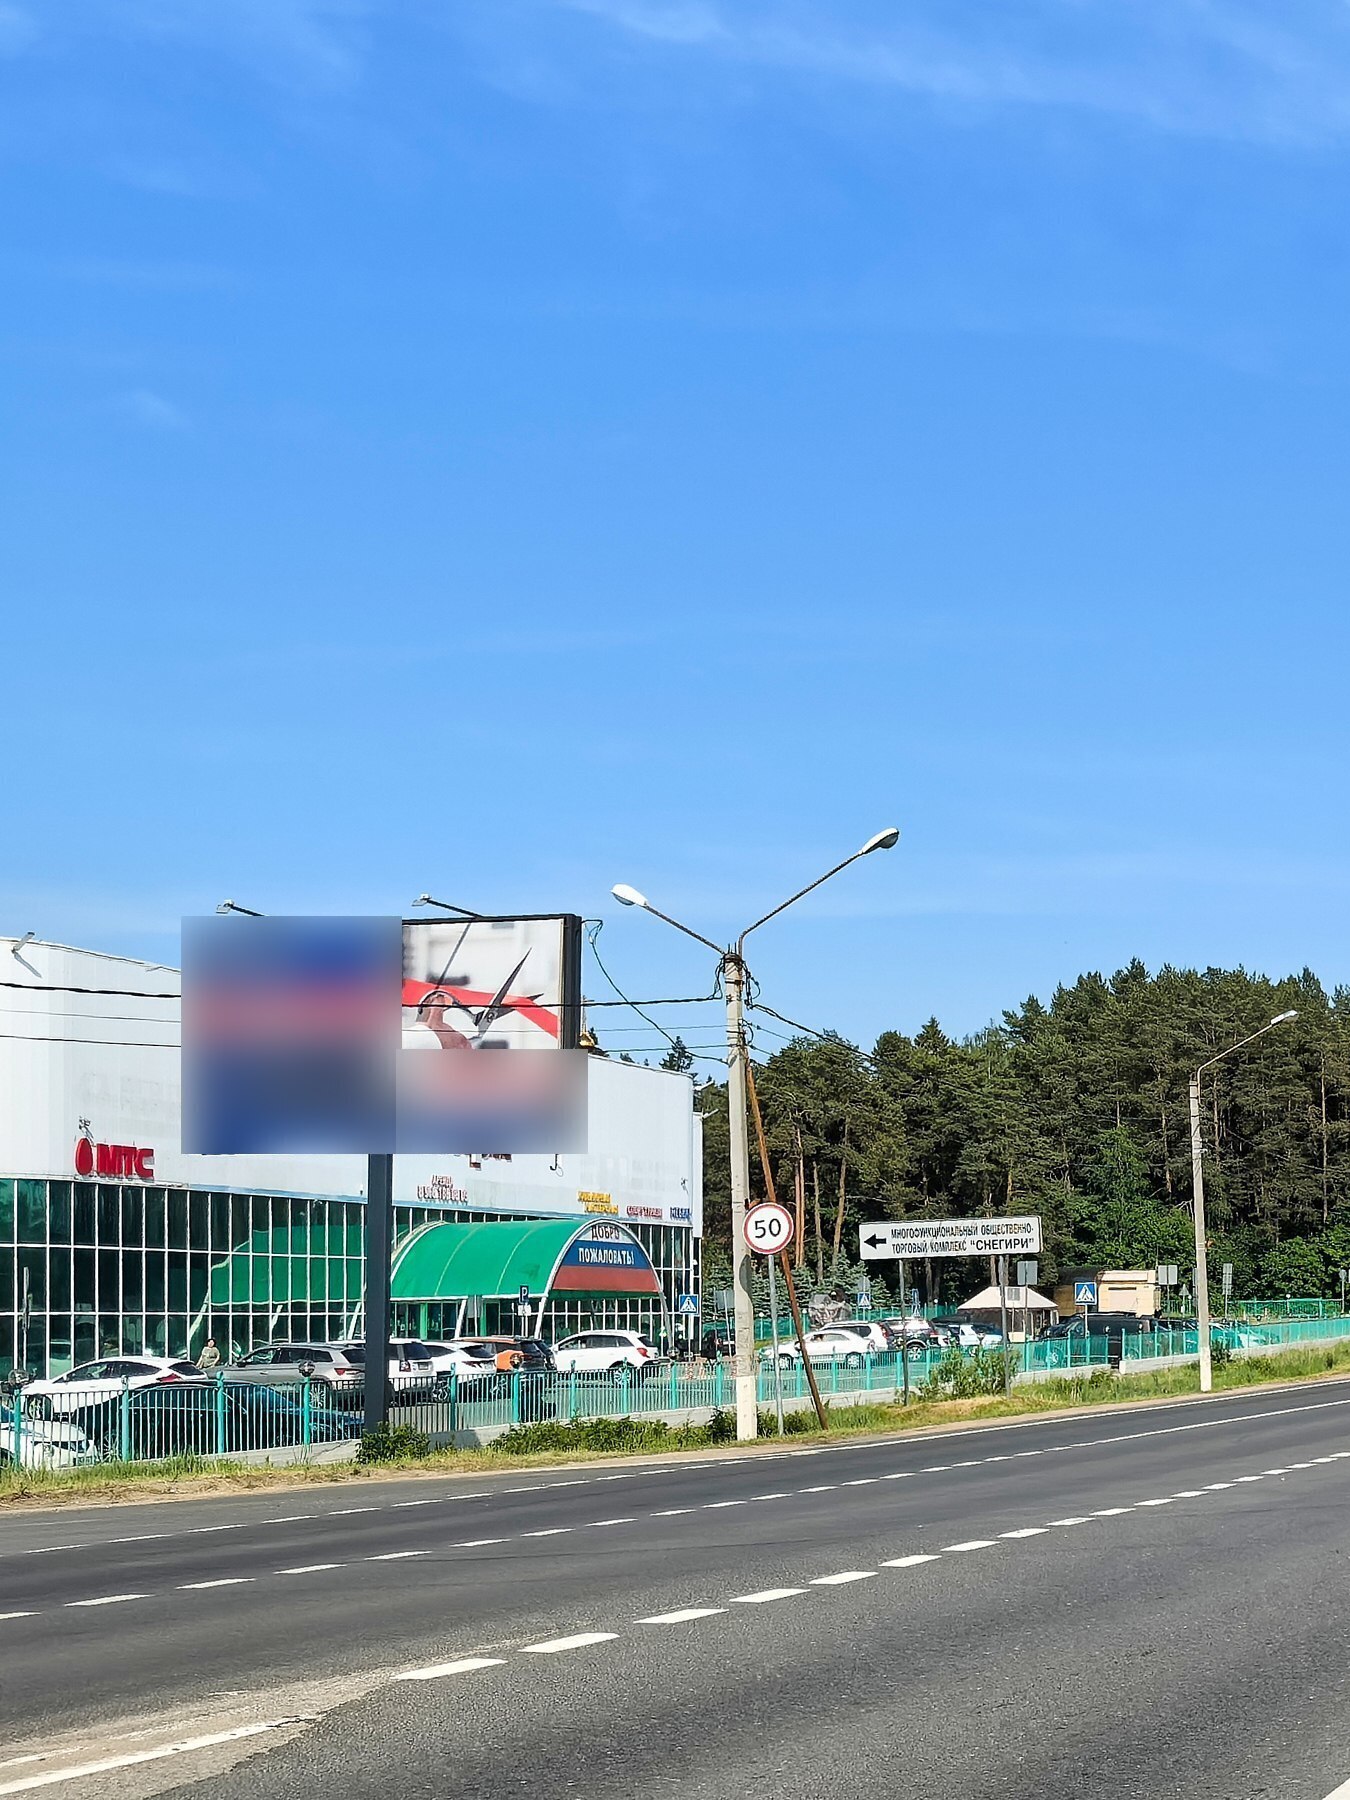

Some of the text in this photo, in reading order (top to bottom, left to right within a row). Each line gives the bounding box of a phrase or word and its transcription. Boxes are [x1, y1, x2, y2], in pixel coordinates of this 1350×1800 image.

[96, 1143, 154, 1179] МТС
[591, 1224, 620, 1240] ДОБРО
[754, 1218, 781, 1239] 50
[892, 1239, 928, 1254] ТОРГОВЫЙ
[930, 1239, 967, 1253] КОМПЛЕКС
[578, 1247, 635, 1265] ПОЖАЛОВАТЬ!
